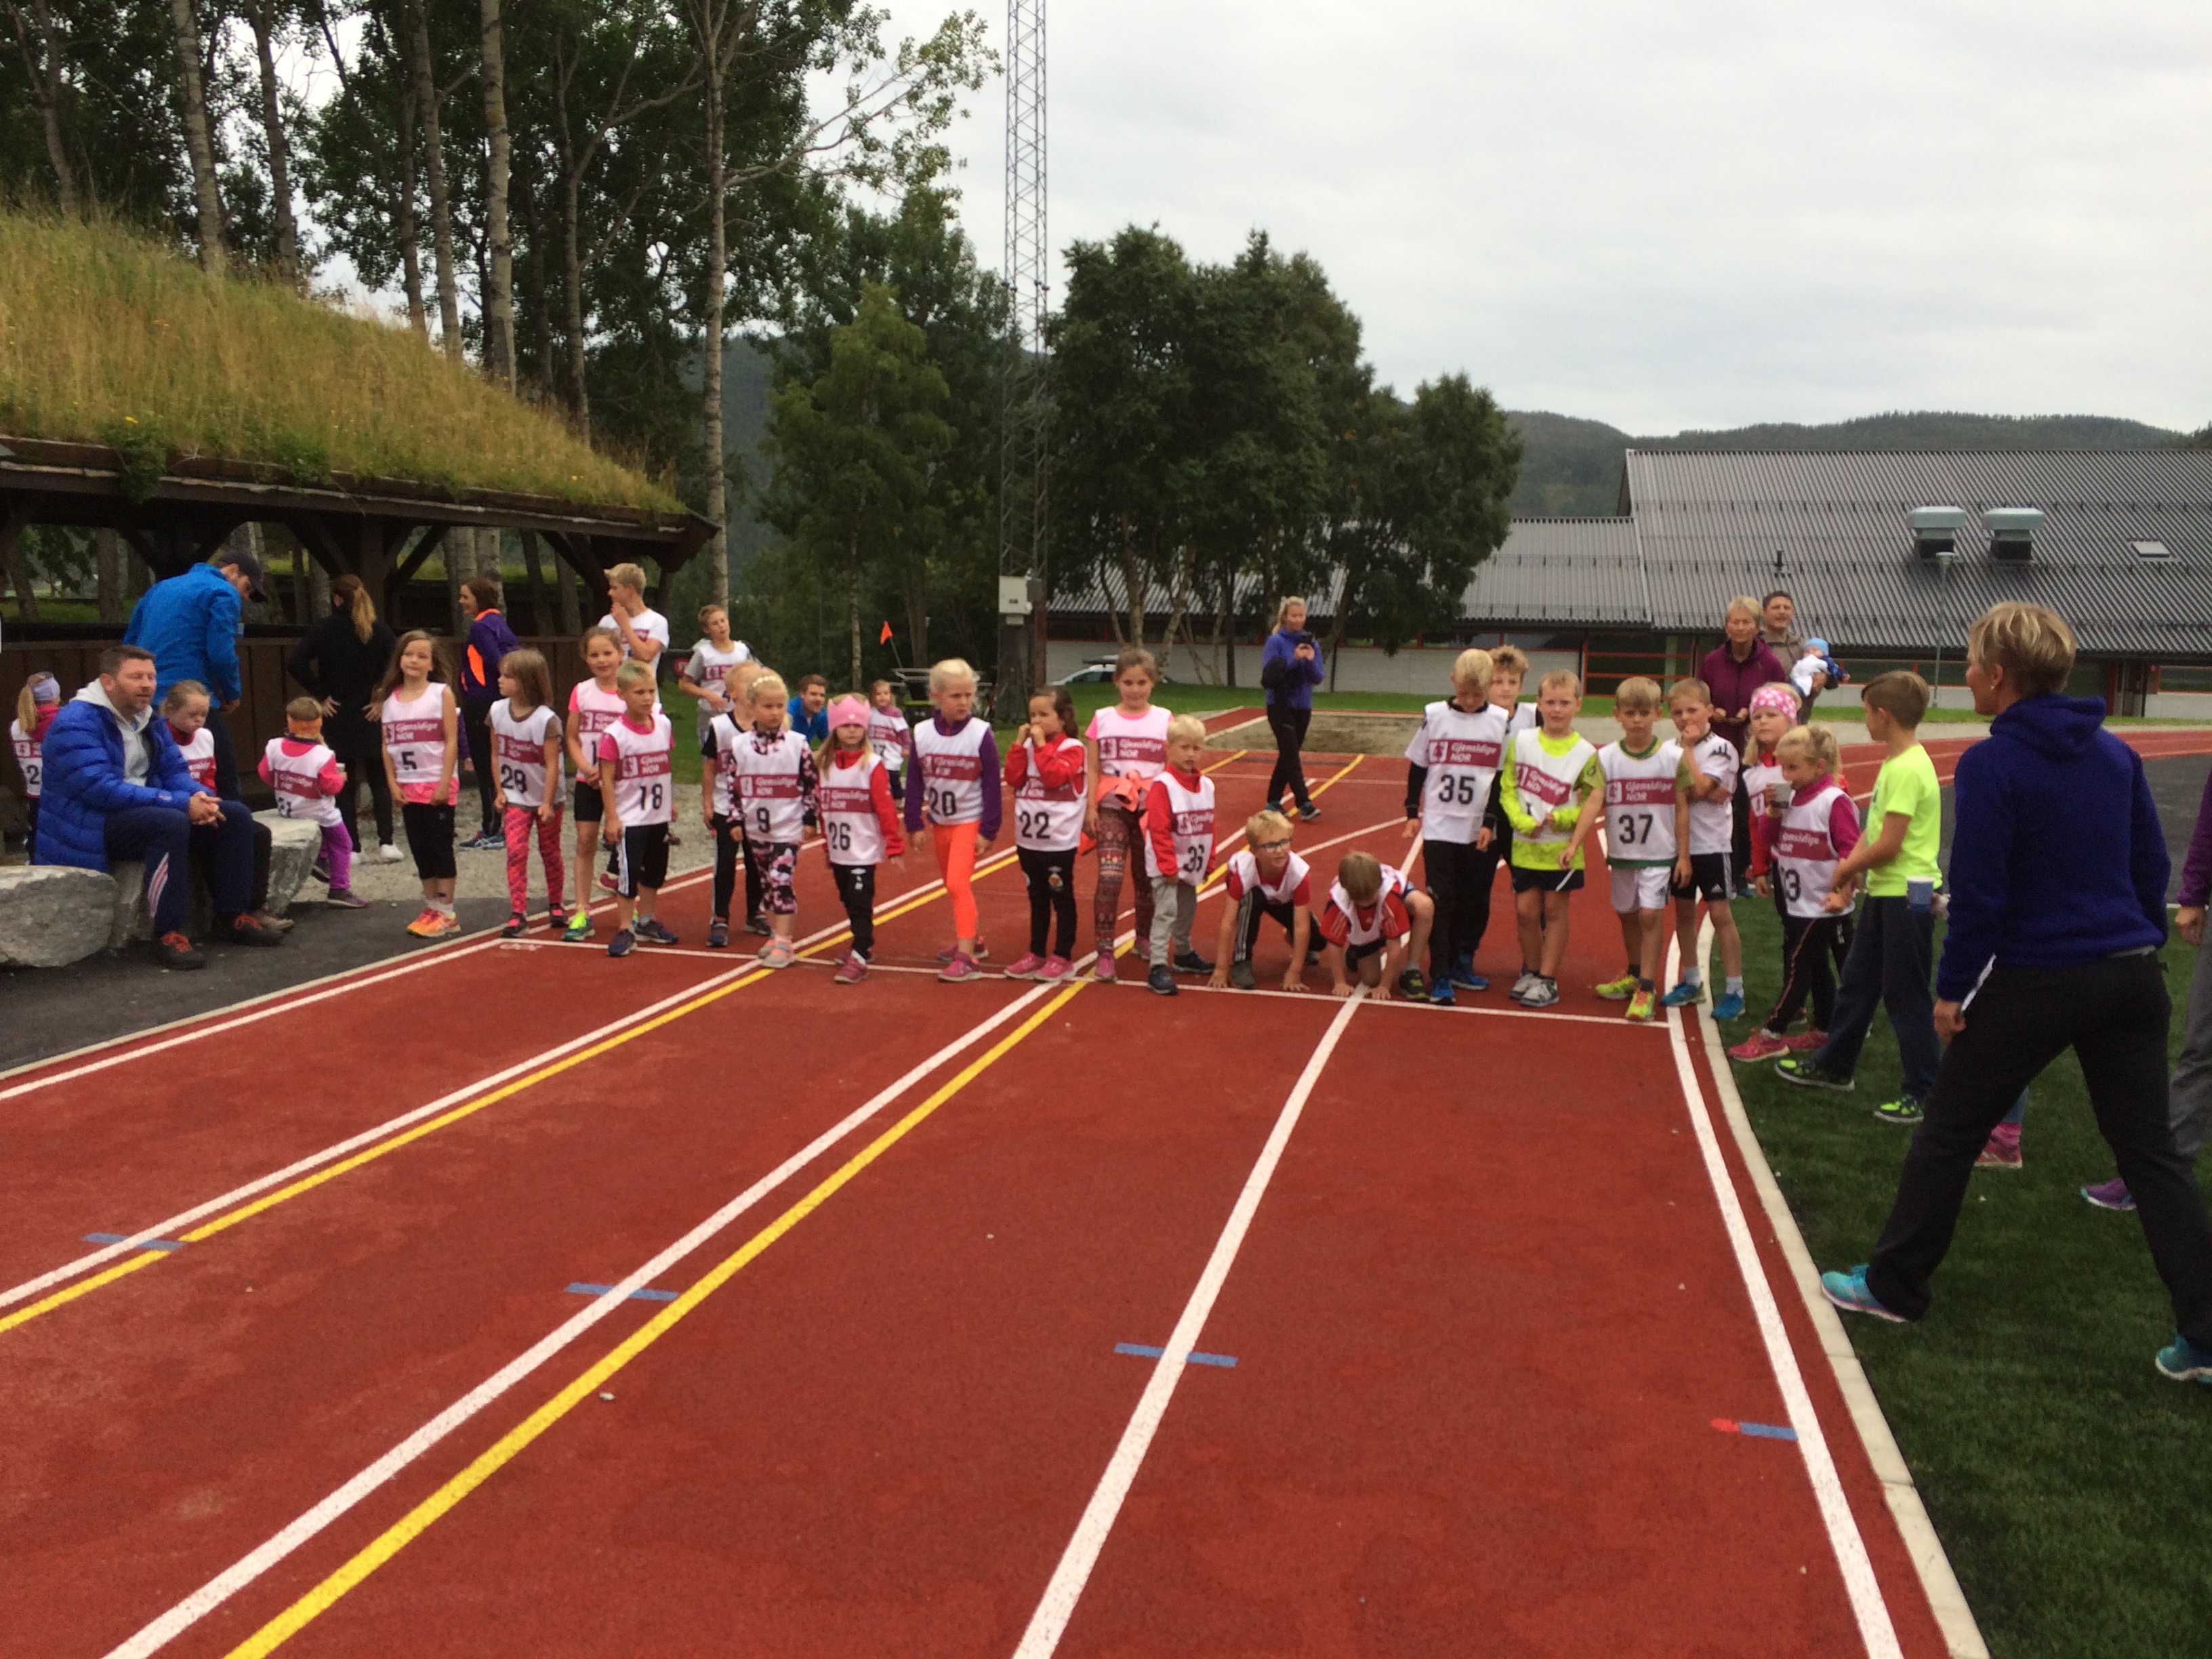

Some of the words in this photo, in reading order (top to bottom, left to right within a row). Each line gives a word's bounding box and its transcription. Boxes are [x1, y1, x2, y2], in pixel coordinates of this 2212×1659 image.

[402, 751, 417, 770] 5
[1451, 742, 1497, 756] Gjensidige
[1451, 753, 1471, 762] NOR
[501, 764, 527, 794] 29
[1438, 774, 1476, 805] 35
[640, 783, 663, 811] 18
[929, 787, 957, 817] 20
[756, 806, 771, 834] 9
[1019, 811, 1050, 840] 22
[1618, 814, 1654, 844] 37
[828, 821, 851, 851] 26
